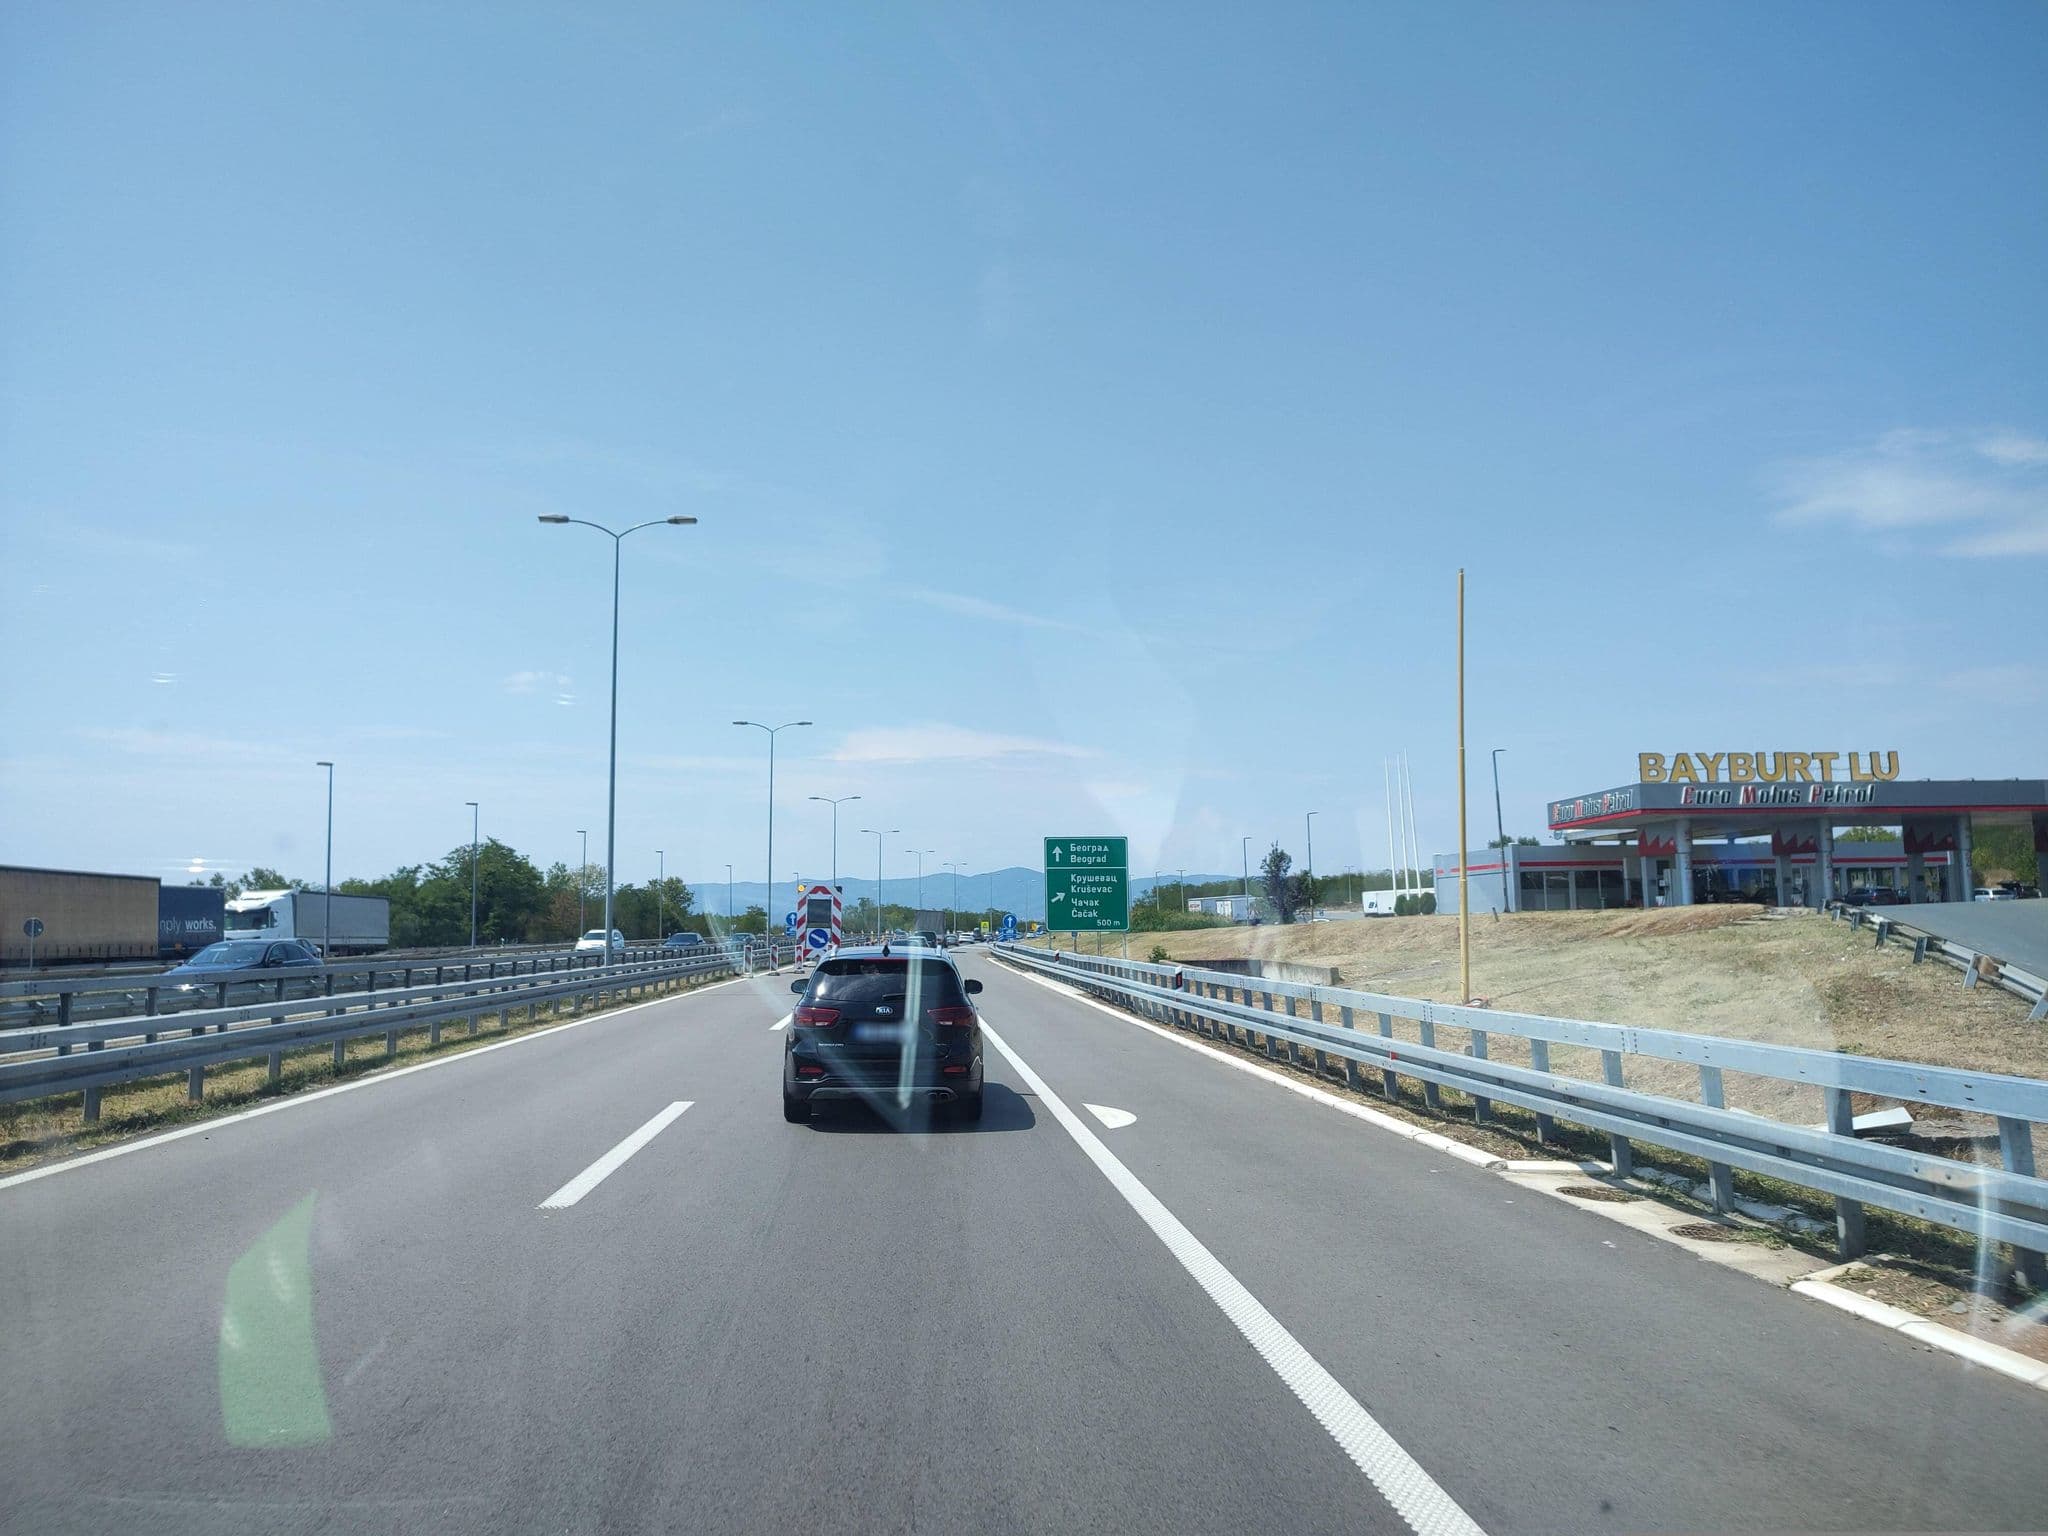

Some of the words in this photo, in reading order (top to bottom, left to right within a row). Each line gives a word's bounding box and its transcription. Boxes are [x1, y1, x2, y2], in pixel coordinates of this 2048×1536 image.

[1638, 752, 1839, 783] BAYBURT
[1849, 750, 1900, 782] LU
[1680, 786, 1731, 806] Euro
[1808, 784, 1875, 804] Petrol
[1070, 843, 1109, 853] Београд
[1070, 855, 1107, 864] Beograd
[1070, 874, 1117, 883] Крушевац
[1071, 884, 1113, 893] Kruševac
[1071, 898, 1100, 906] Чачак
[1072, 908, 1098, 918] Čačak
[185, 917, 217, 931] works.
